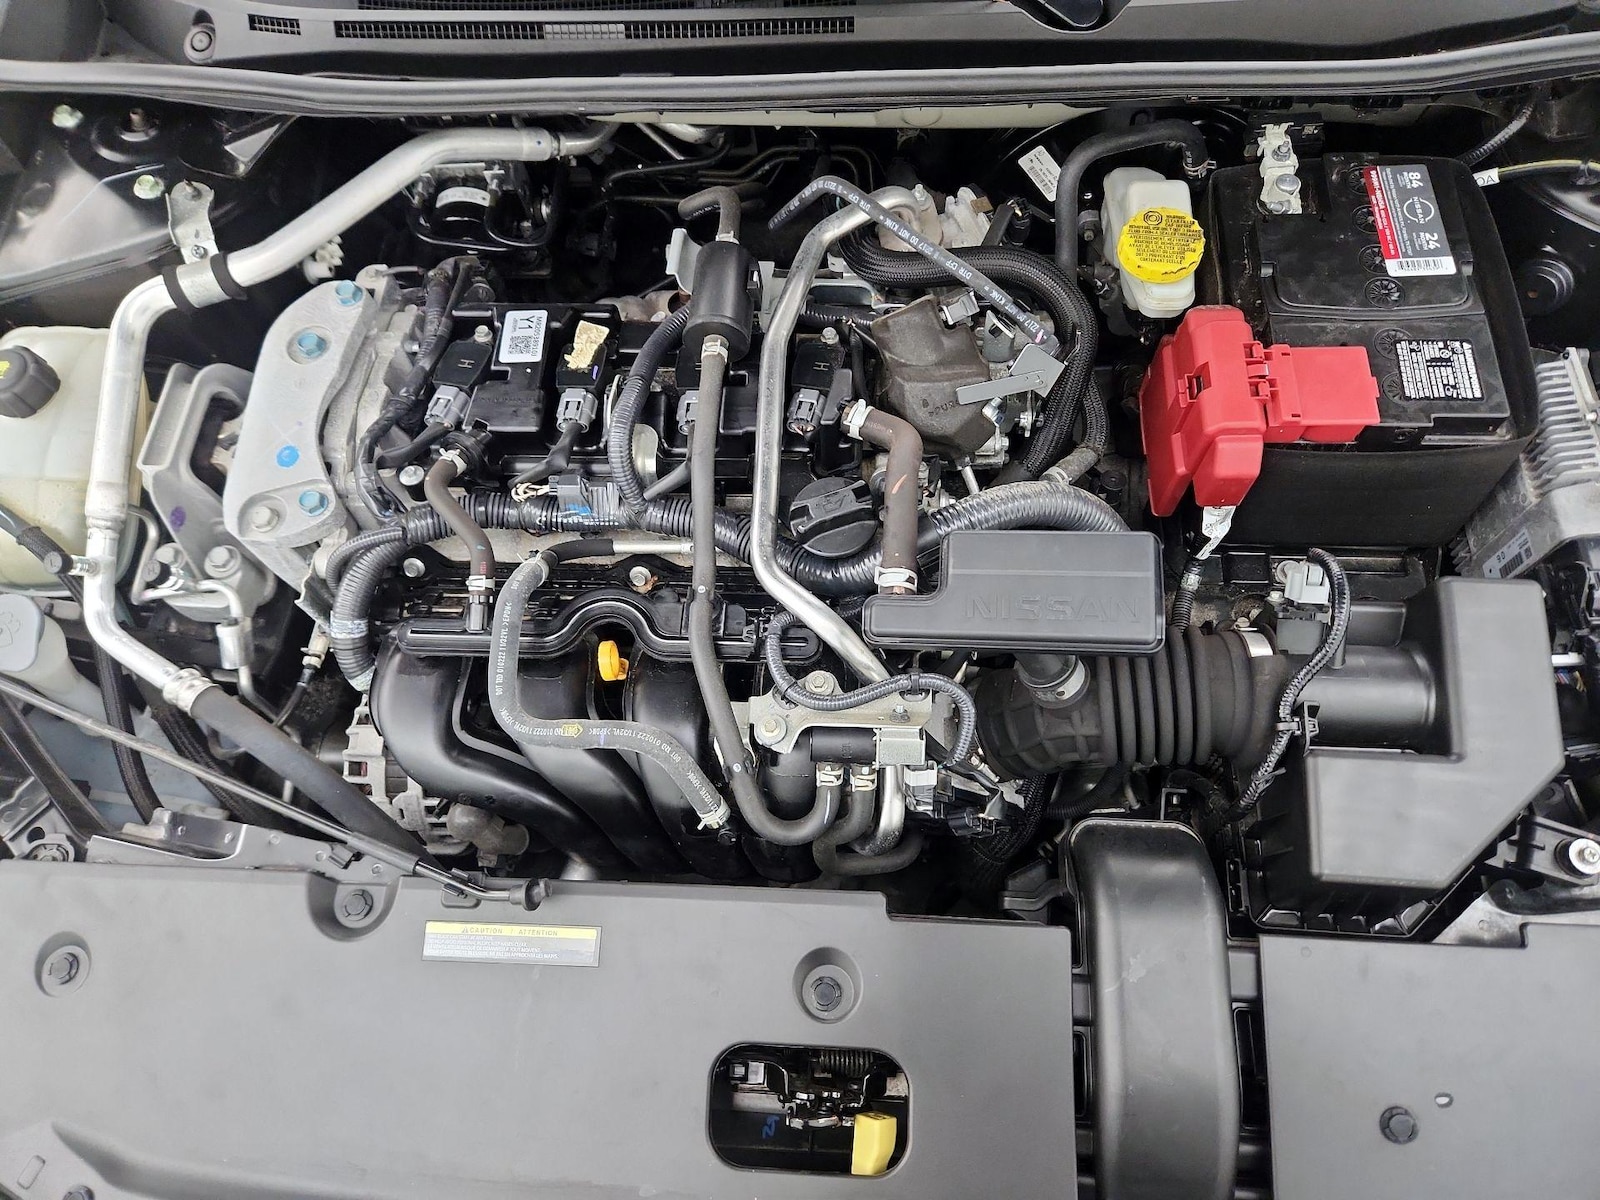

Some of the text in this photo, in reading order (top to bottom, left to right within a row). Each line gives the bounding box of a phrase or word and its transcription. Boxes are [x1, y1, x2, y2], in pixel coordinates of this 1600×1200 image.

[1409, 172, 1423, 188] 84
[1413, 196, 1425, 224] NISSAN
[1426, 233, 1440, 250] 24
[990, 290, 1006, 305] KINK
[518, 316, 535, 329] Y1
[966, 594, 1140, 623] NISSAN
